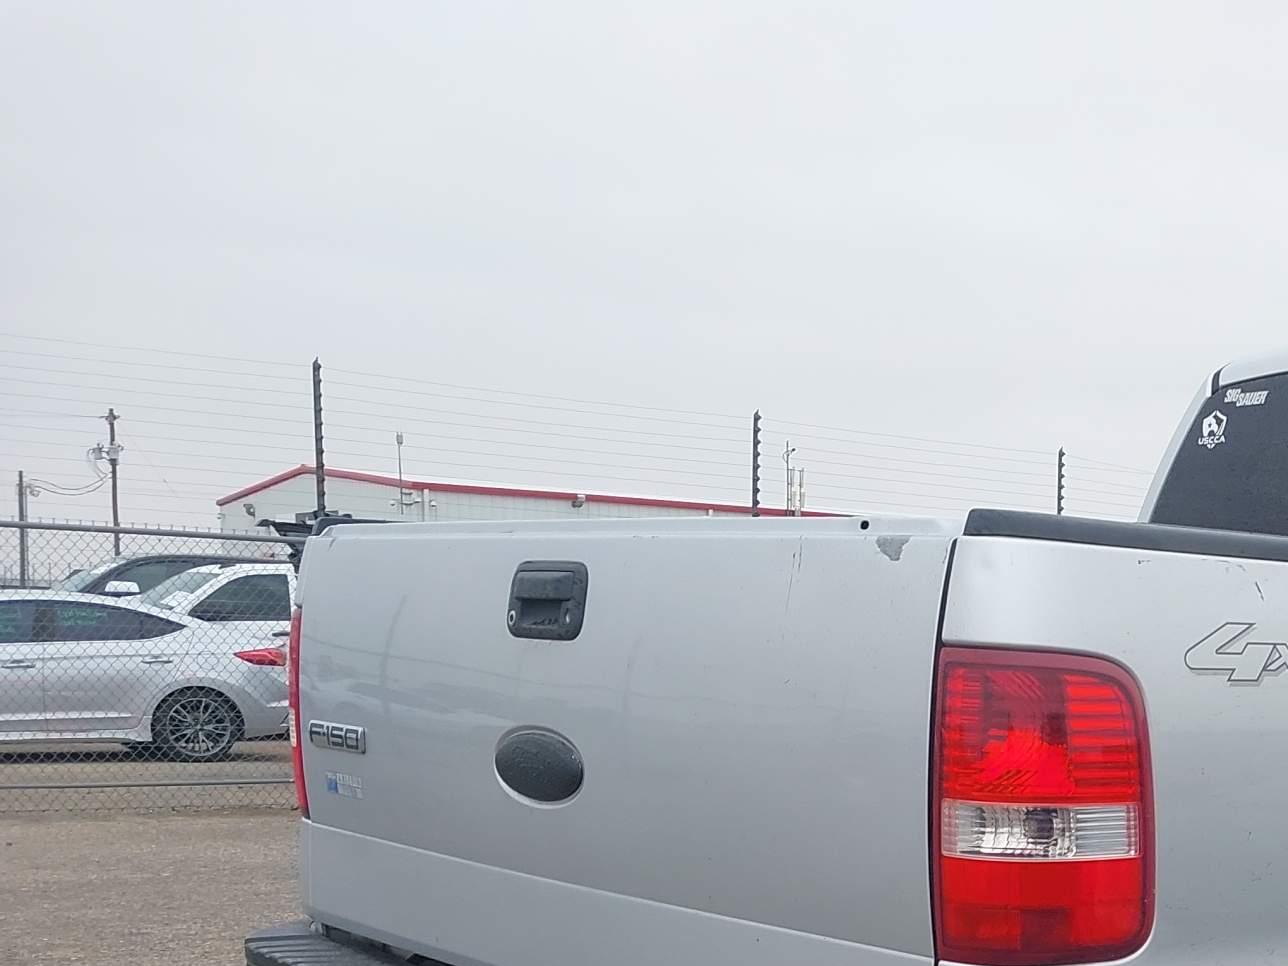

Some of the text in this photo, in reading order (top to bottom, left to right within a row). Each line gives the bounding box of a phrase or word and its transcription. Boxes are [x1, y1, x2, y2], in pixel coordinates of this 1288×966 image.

[1224, 388, 1269, 407] SIG SAUER
[1198, 435, 1226, 445] USCCA
